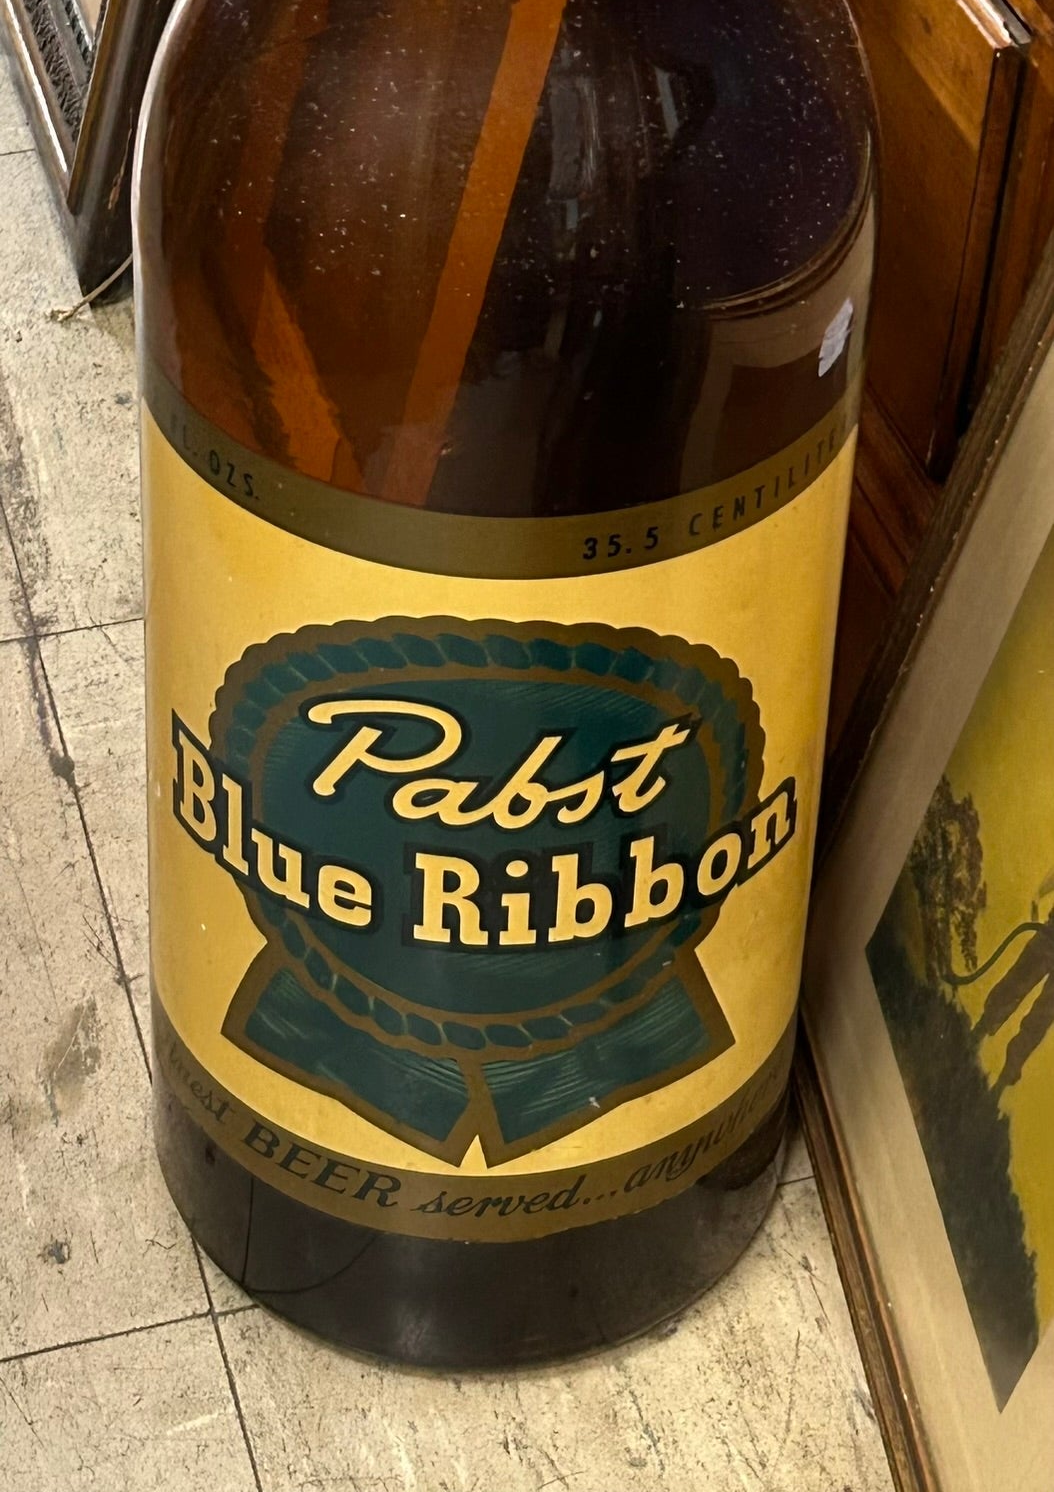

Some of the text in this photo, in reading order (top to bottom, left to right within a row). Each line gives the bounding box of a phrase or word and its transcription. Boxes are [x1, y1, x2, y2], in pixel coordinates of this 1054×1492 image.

[209, 449, 260, 501] OZS.
[582, 526, 660, 560] 35.5
[306, 698, 694, 831] Pabst
[175, 733, 798, 947] Blue Ribbon
[241, 1121, 402, 1208] BEER
